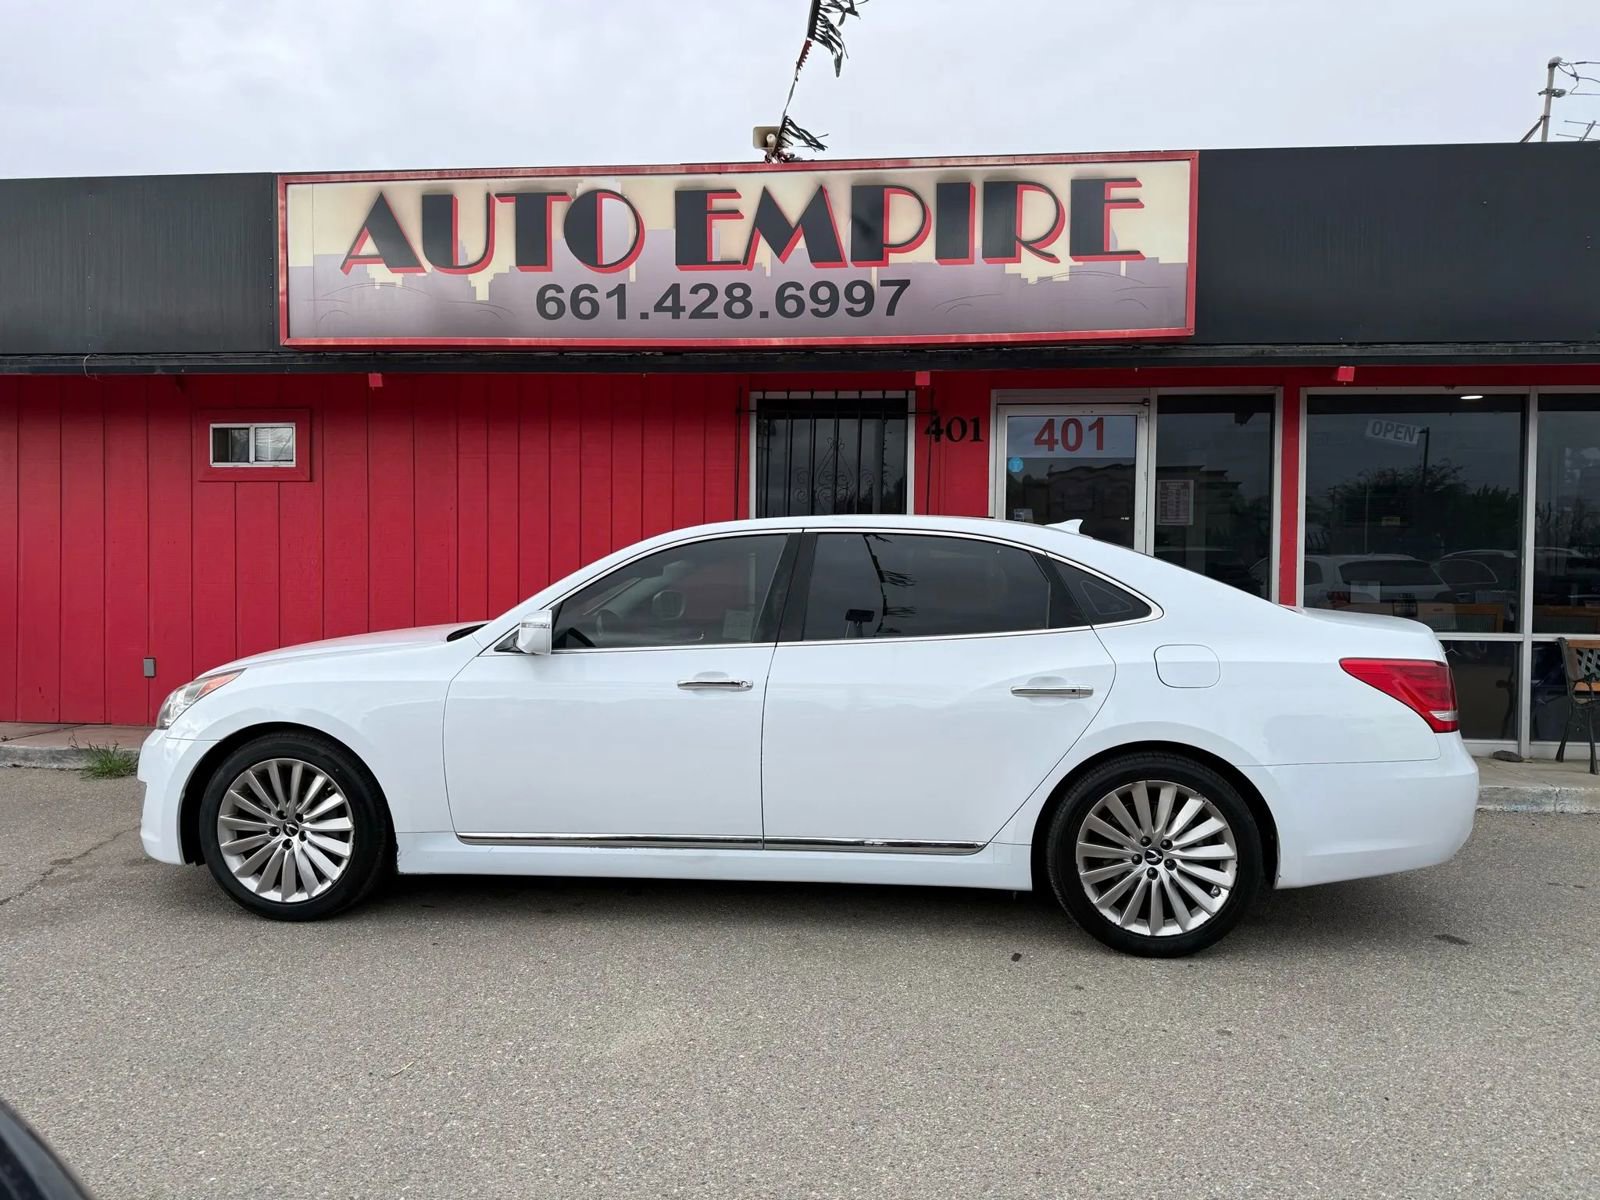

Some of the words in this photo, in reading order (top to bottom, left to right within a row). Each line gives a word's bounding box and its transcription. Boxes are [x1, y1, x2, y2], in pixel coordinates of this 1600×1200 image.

[340, 188, 645, 275] AUTO
[676, 177, 1146, 270] EMPIRE
[536, 279, 911, 321] 661.428.6997
[924, 416, 984, 442] 401
[1033, 417, 1105, 451] 401
[1371, 420, 1416, 442] OPEN
